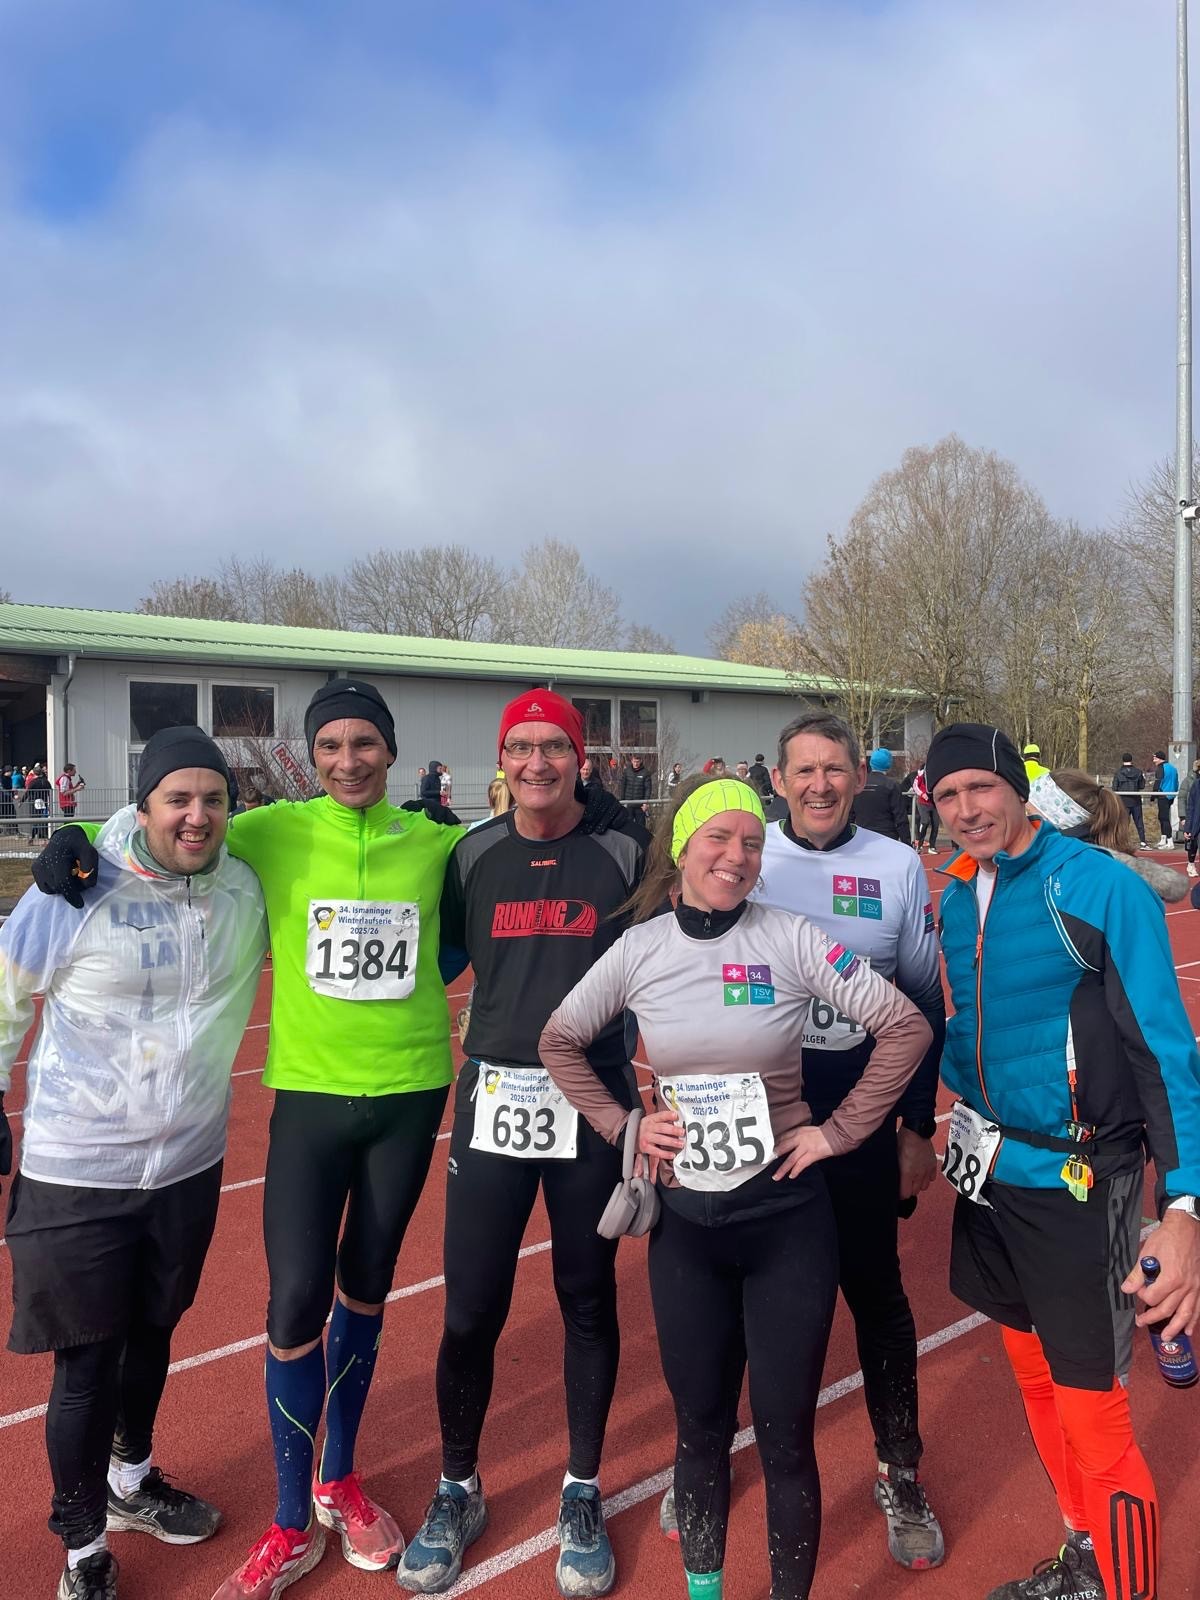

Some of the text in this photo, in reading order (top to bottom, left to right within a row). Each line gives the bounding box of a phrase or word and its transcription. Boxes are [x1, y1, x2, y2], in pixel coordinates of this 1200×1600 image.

[339, 906, 392, 917] 34. Ismaninger
[862, 902, 879, 911] TSV
[338, 916, 392, 925] Winterlaufserie
[350, 927, 379, 935] 2025/26
[315, 938, 409, 981] 1384
[753, 988, 771, 996] TSV
[513, 1071, 550, 1083] Ismaninger
[501, 1081, 550, 1092] Winterlaufserie
[685, 1080, 727, 1091] Ismaninger
[510, 1094, 537, 1103] 2025/26
[691, 1106, 719, 1116] 2025/26
[492, 1104, 556, 1151] 633
